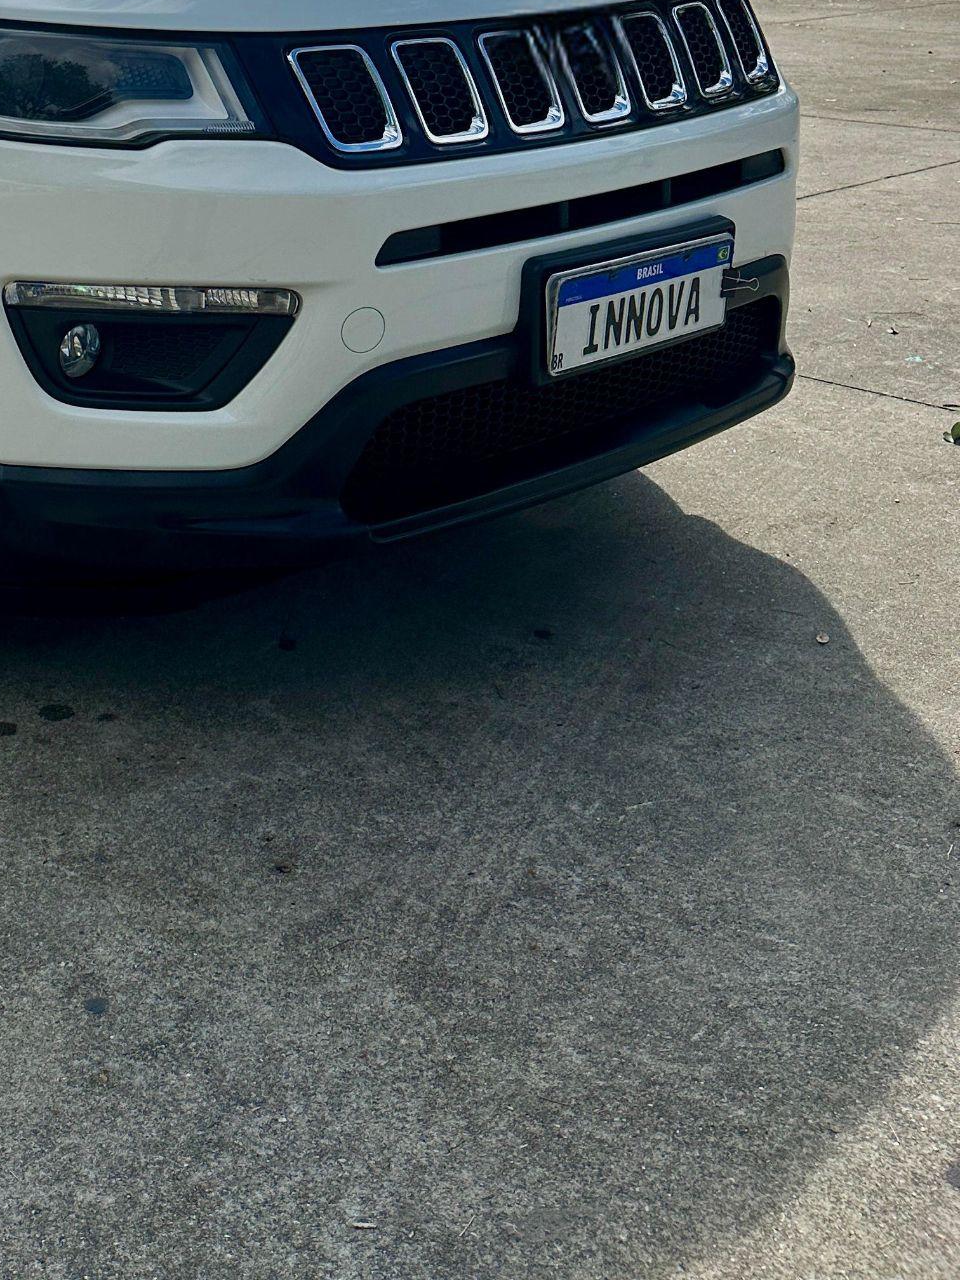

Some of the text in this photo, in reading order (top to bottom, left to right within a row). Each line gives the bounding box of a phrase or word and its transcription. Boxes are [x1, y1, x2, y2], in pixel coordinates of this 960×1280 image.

[637, 263, 664, 280] BRASIL
[583, 277, 700, 355] INNOVA
[551, 352, 564, 370] BR
